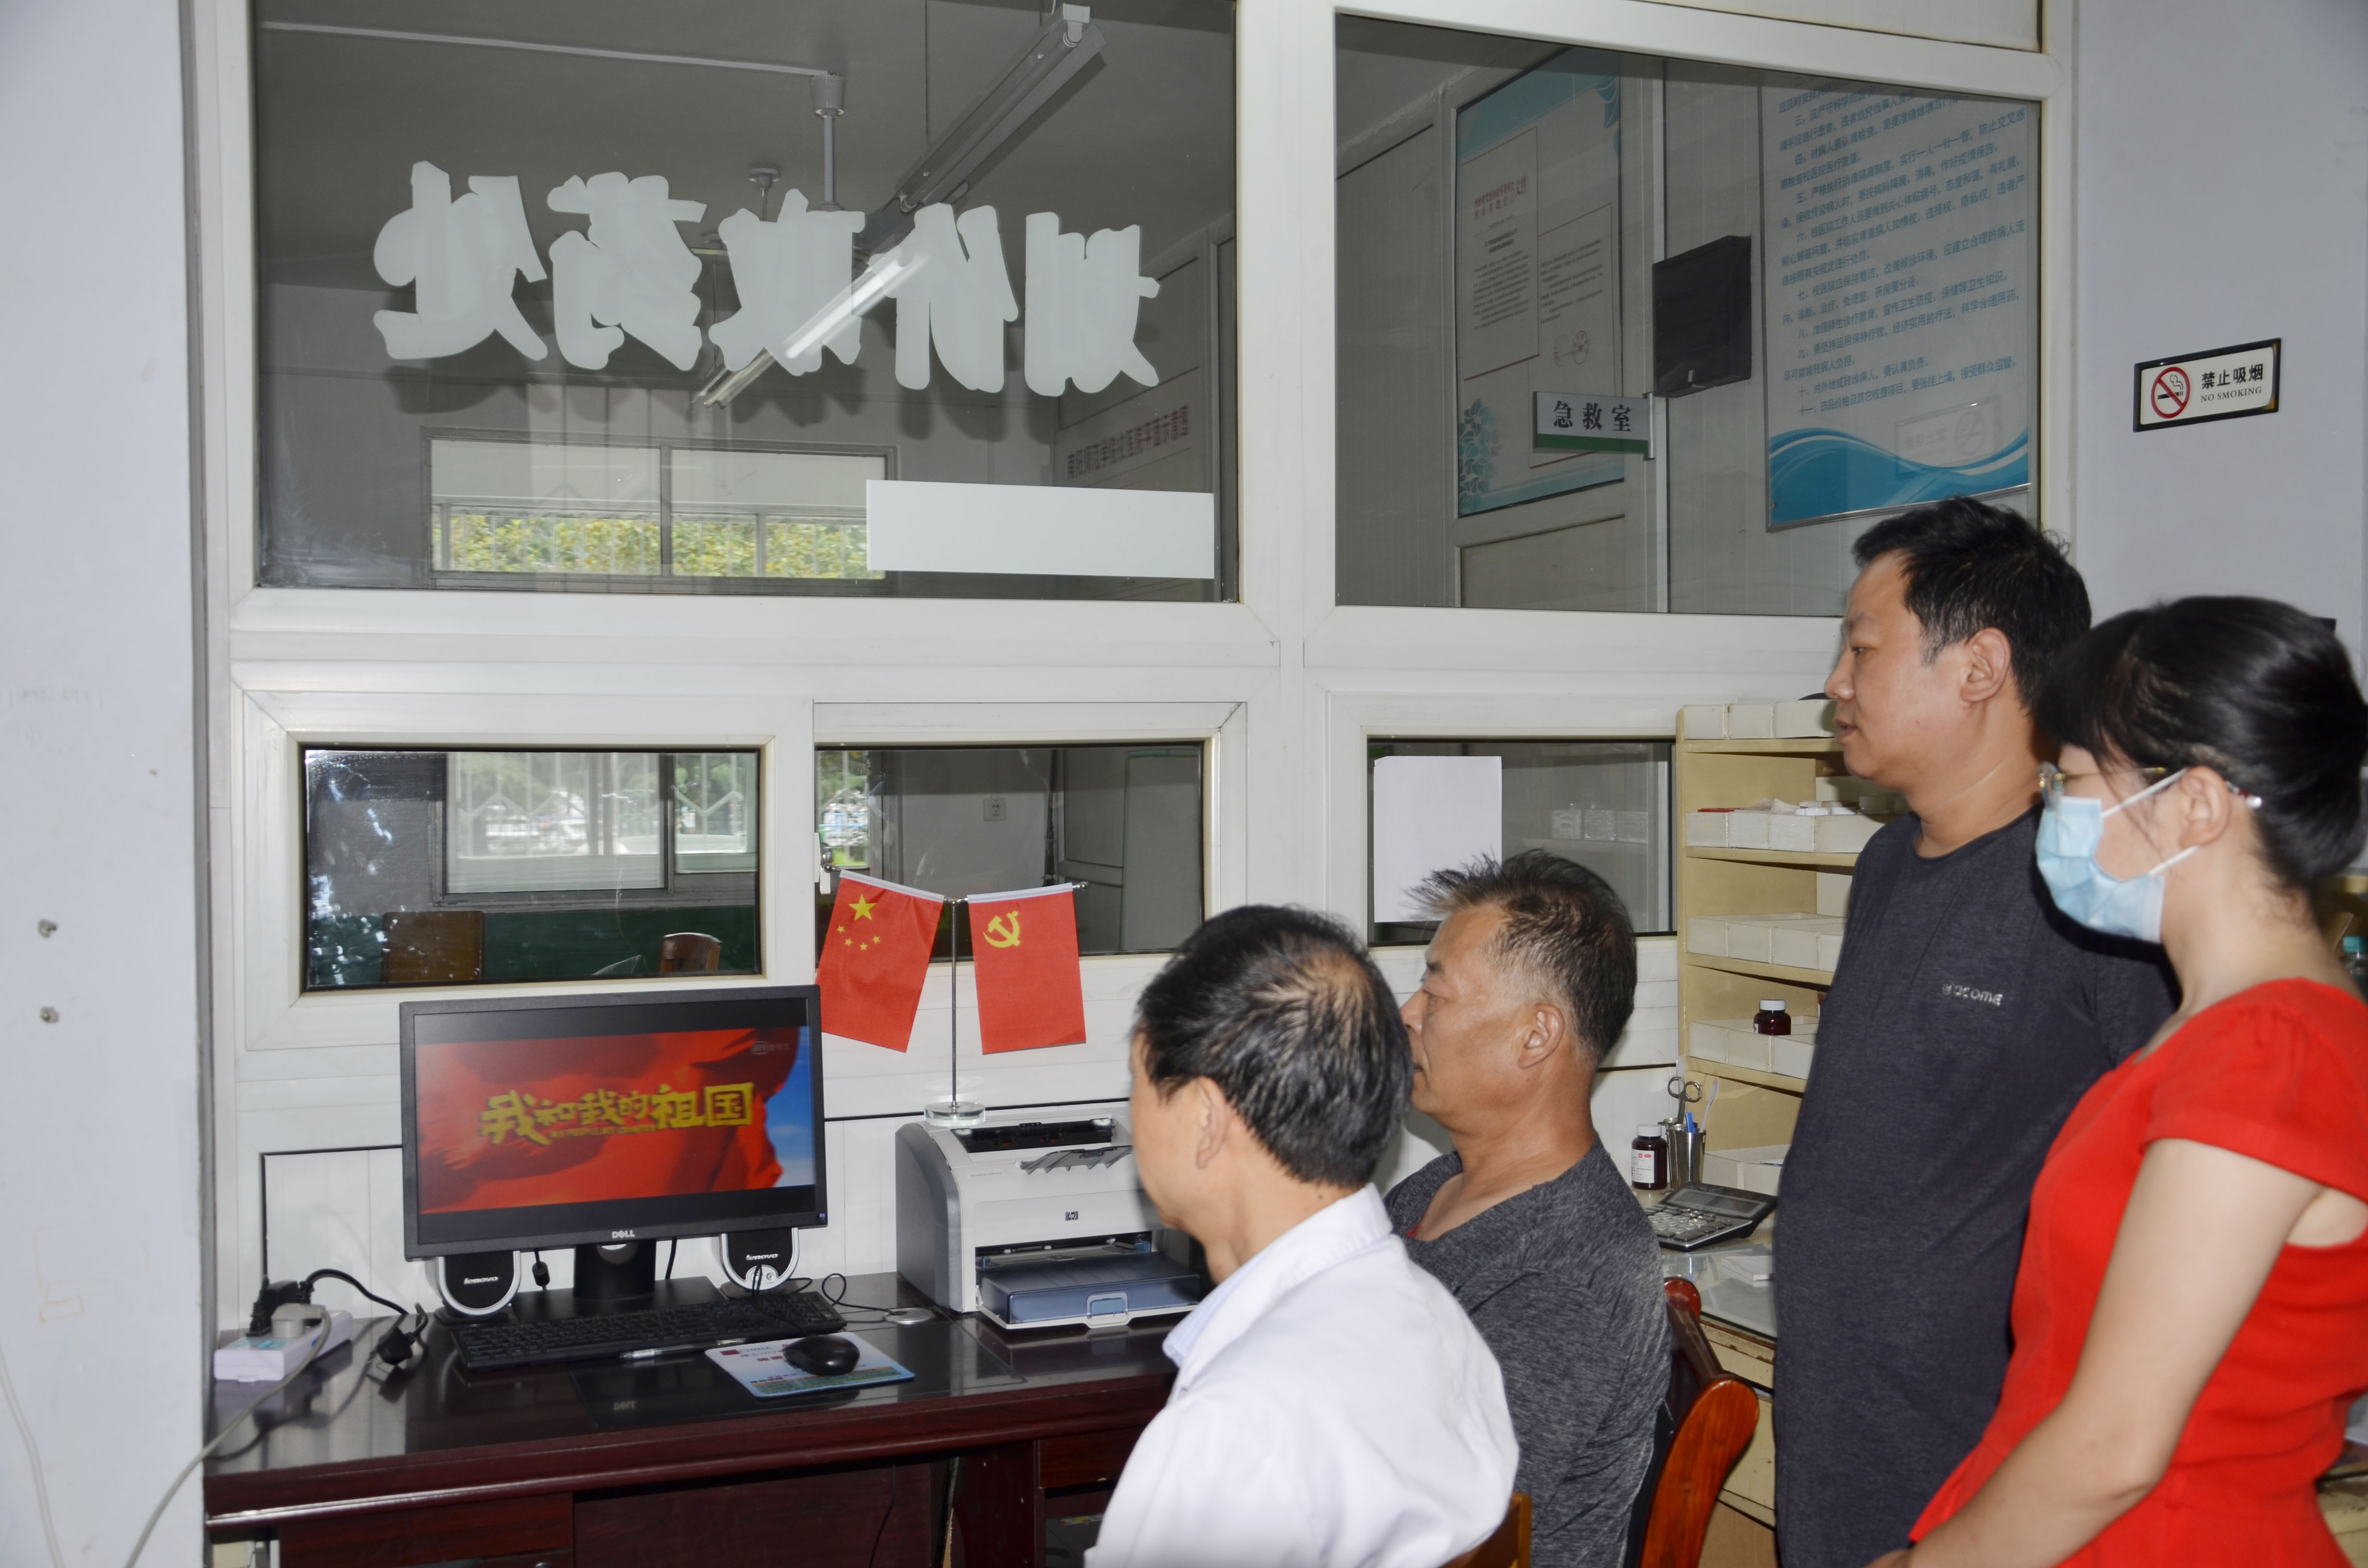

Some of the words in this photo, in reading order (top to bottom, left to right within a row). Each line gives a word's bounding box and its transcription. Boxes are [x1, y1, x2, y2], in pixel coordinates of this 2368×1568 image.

[2201, 364, 2263, 389] 禁止吸烟
[2201, 393, 2214, 402] NO
[2217, 386, 2262, 399] SMOKING
[1554, 400, 1631, 431] 急救室
[479, 1082, 754, 1146] 我和我的祖国
[612, 1230, 635, 1238] DELL
